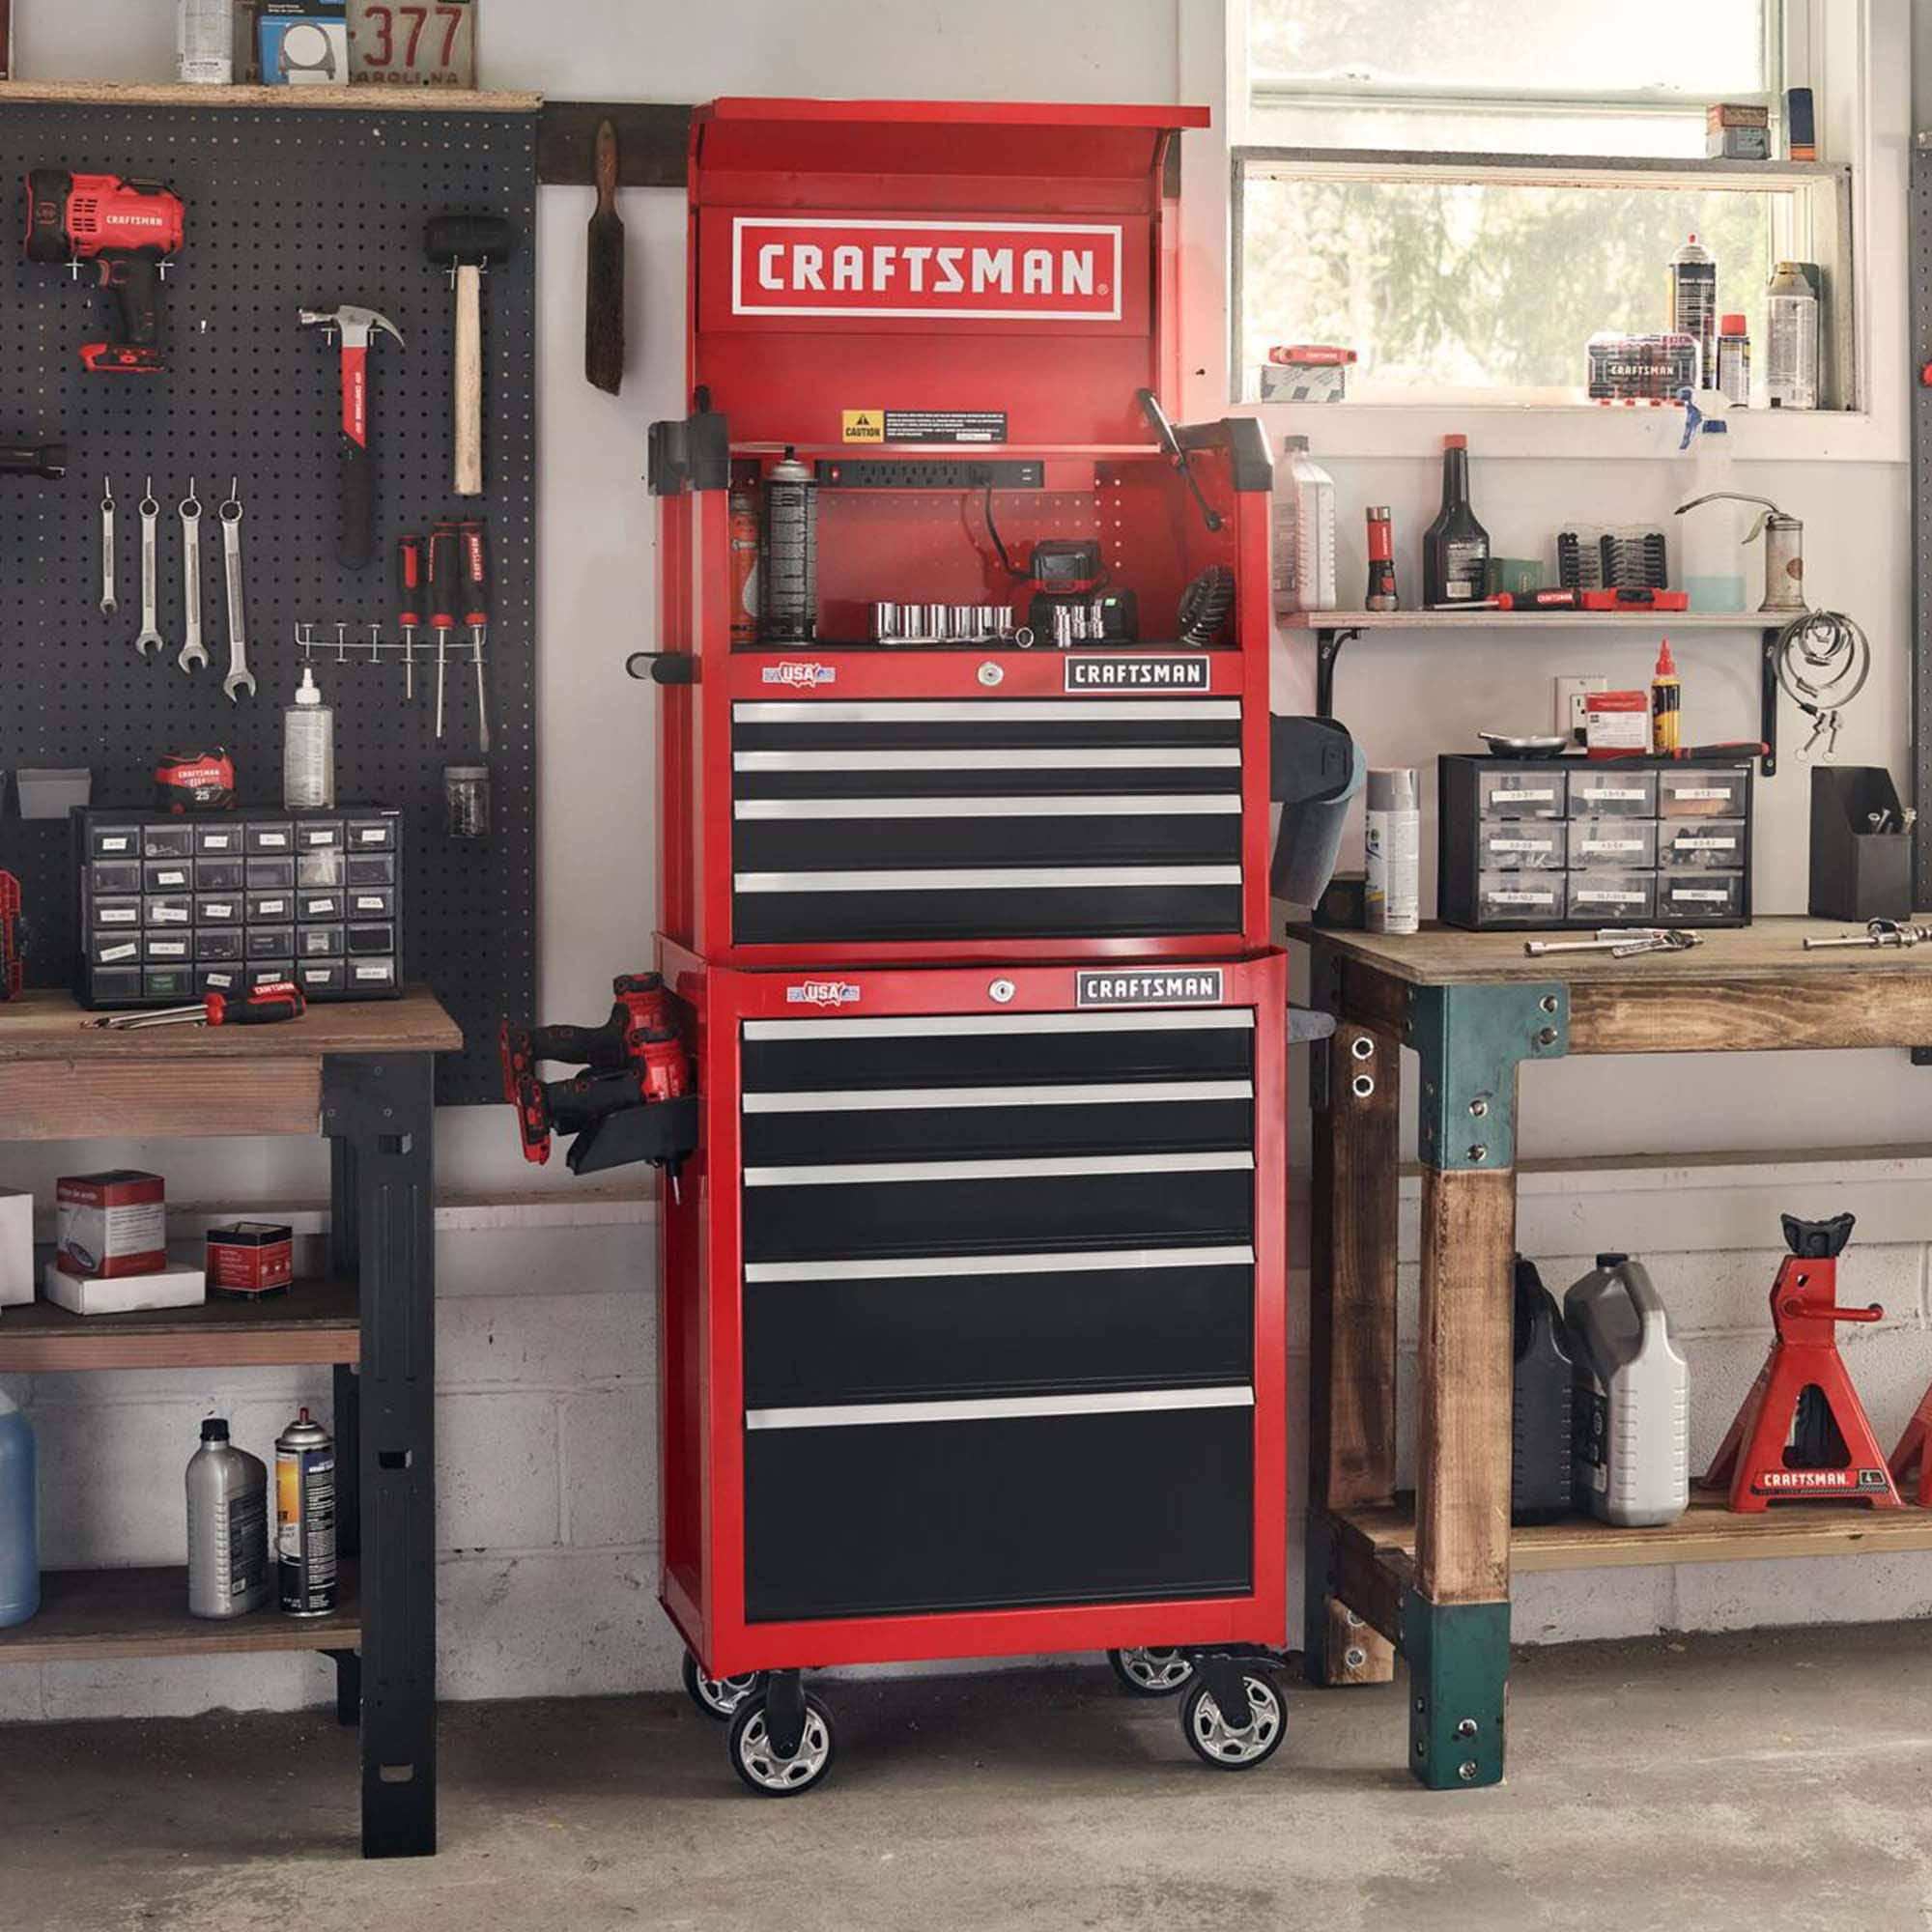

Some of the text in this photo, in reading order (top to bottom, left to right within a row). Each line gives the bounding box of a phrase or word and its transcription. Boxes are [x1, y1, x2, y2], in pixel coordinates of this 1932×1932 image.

[106, 215, 162, 226] CRAFTSMAN
[758, 243, 1094, 295] CRAFTSMAN
[1610, 365, 1674, 376] CRAFTSMAN
[845, 427, 881, 437] CAUTION
[471, 537, 482, 581] CRAFTSMAN
[781, 666, 814, 681] USA
[1074, 664, 1201, 684] CRAFTSMAN
[178, 769, 220, 779] CRAFTSMAN
[255, 982, 294, 994] CRAFTSMAN
[807, 984, 839, 1000] USA
[1088, 977, 1214, 997] CRAFTSMAN
[1764, 1472, 1846, 1487] CRAFTSMAN
